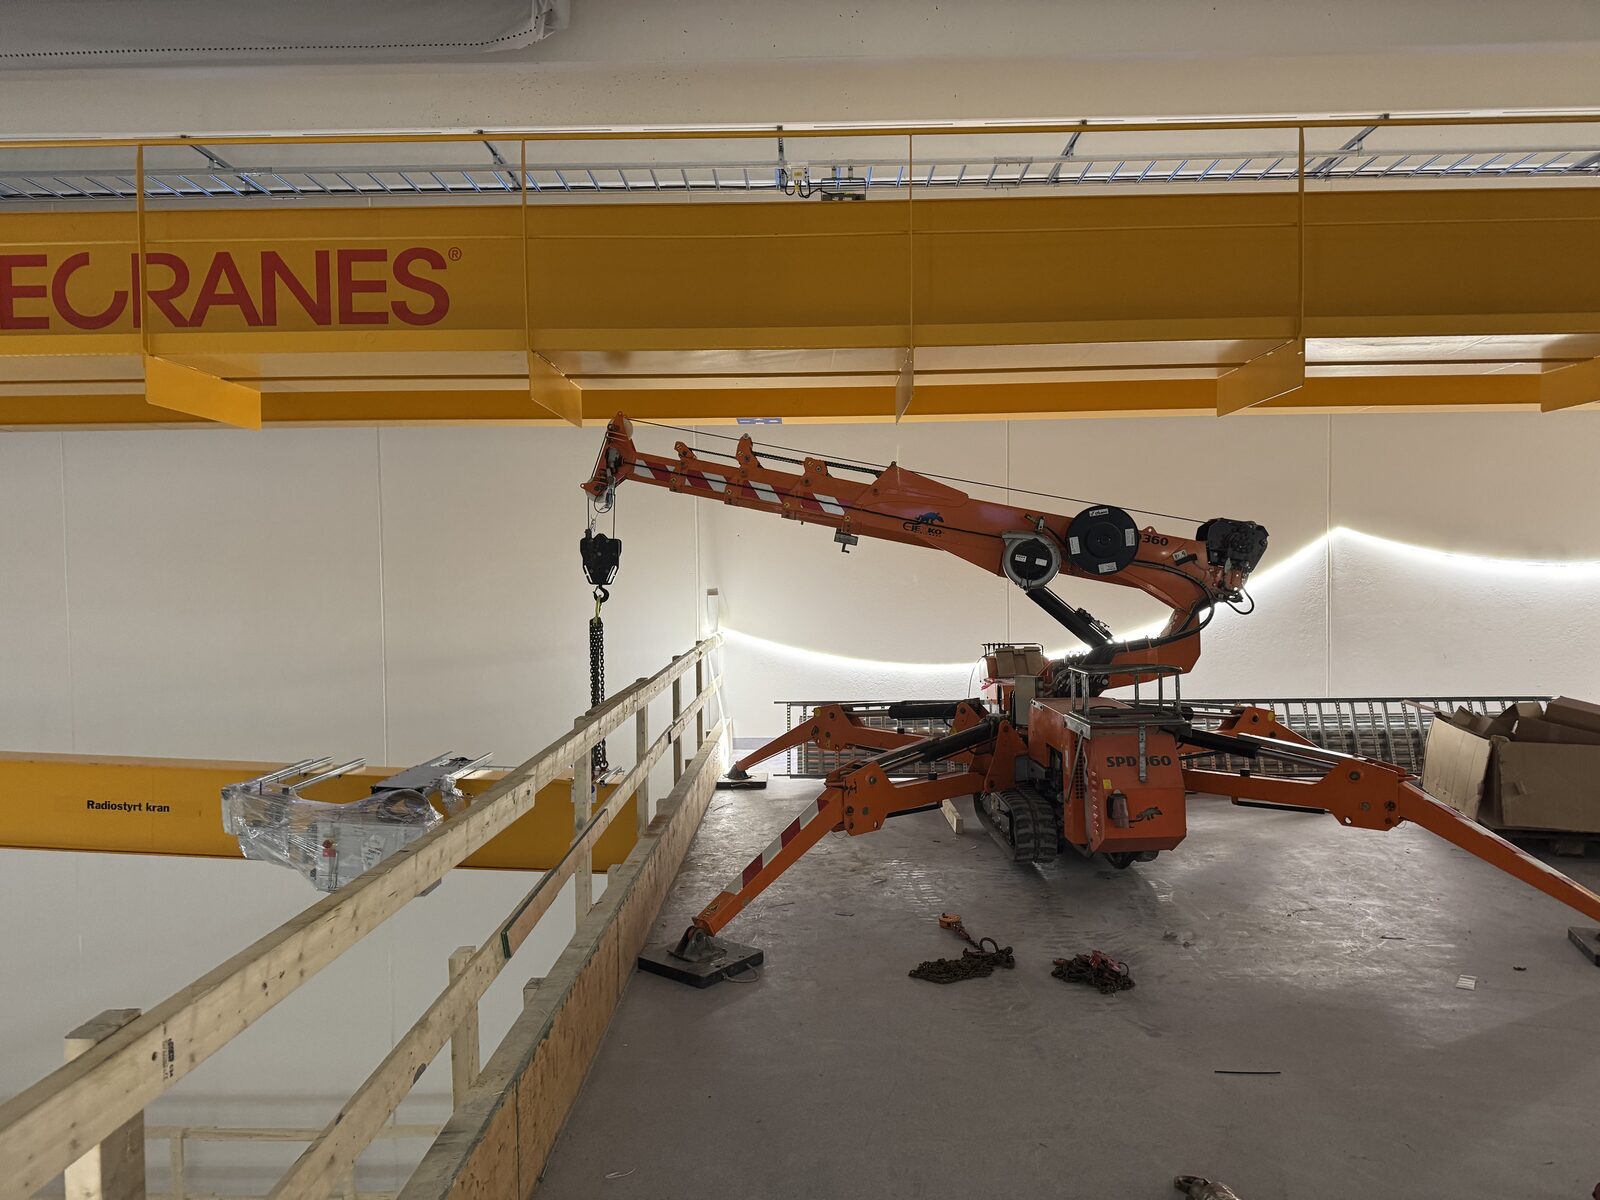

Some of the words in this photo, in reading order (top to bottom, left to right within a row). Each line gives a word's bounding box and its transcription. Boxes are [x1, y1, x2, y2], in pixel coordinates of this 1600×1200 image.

[1106, 756, 1137, 768] SPD
[86, 800, 142, 812] Radiostyrt
[146, 802, 170, 812] kran
